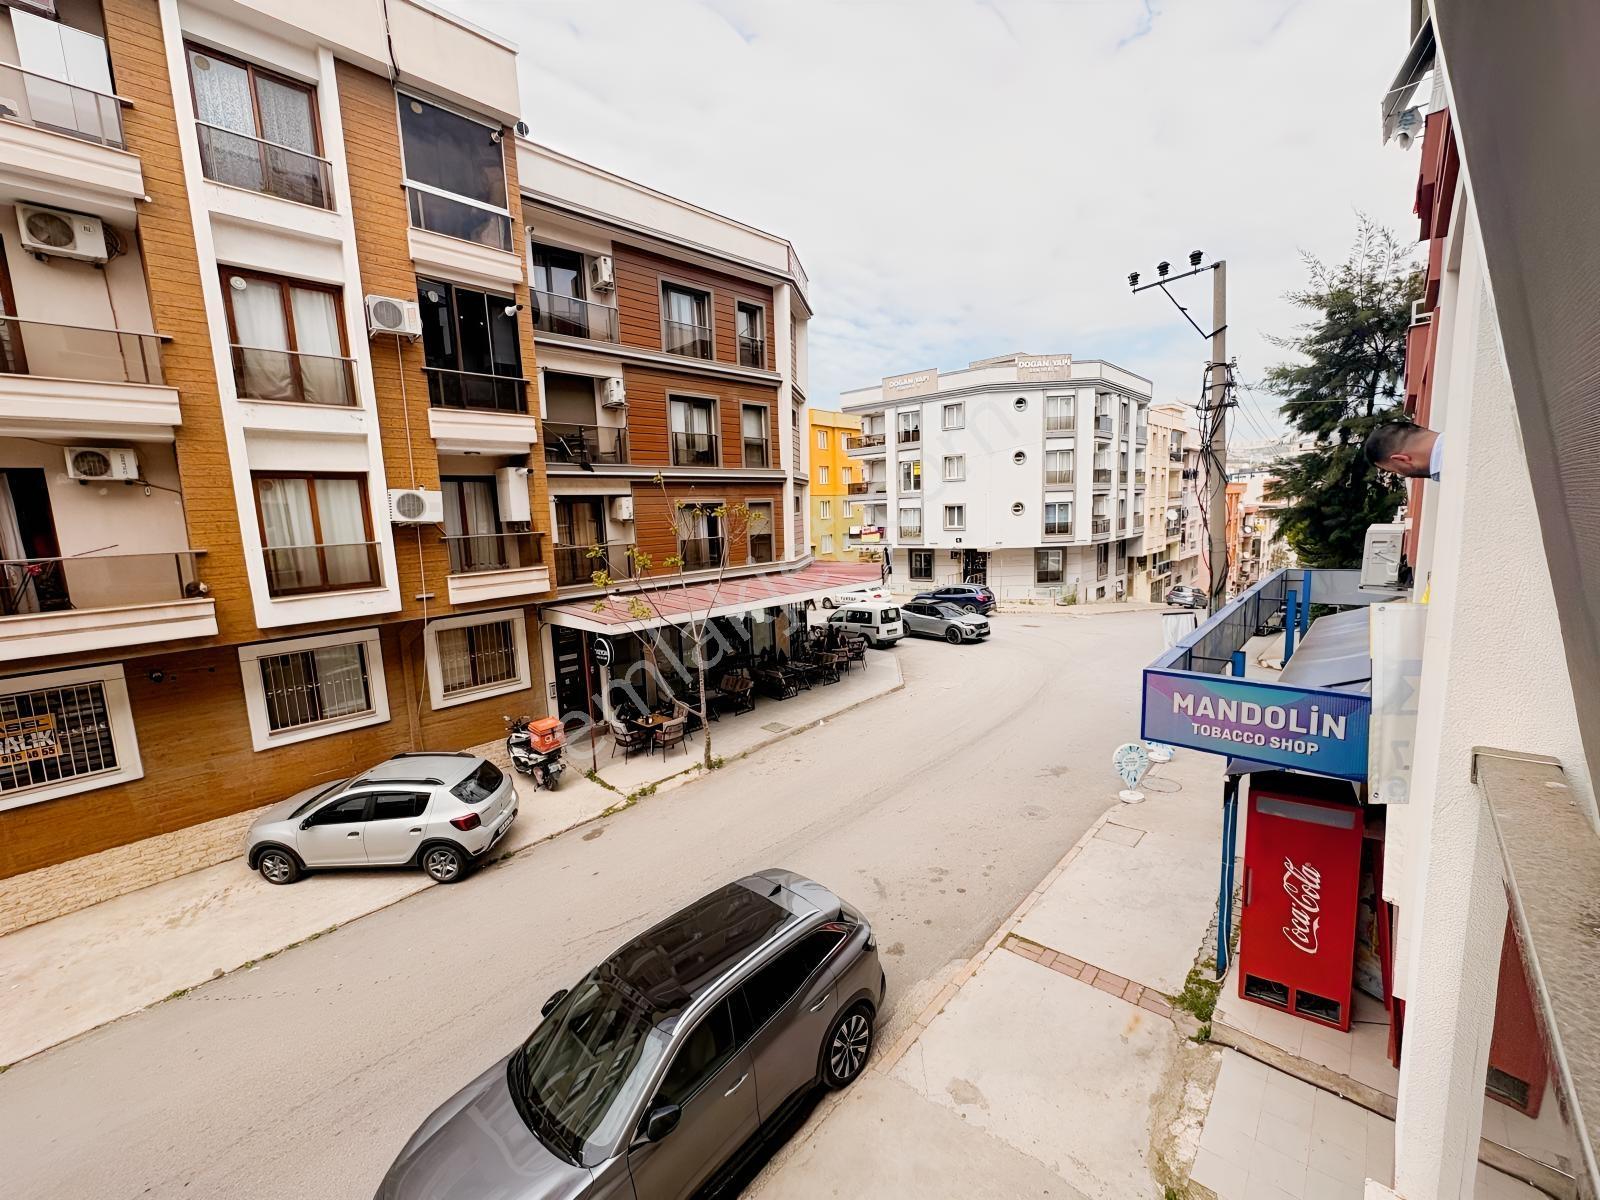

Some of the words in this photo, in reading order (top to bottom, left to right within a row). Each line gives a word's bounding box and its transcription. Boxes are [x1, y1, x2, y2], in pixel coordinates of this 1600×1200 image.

[1173, 691, 1347, 741] MANDOLİN
[1191, 722, 1266, 747] TOBACCO
[1269, 736, 1320, 756] SHOP
[1282, 856, 1321, 954] Coca-Cola
